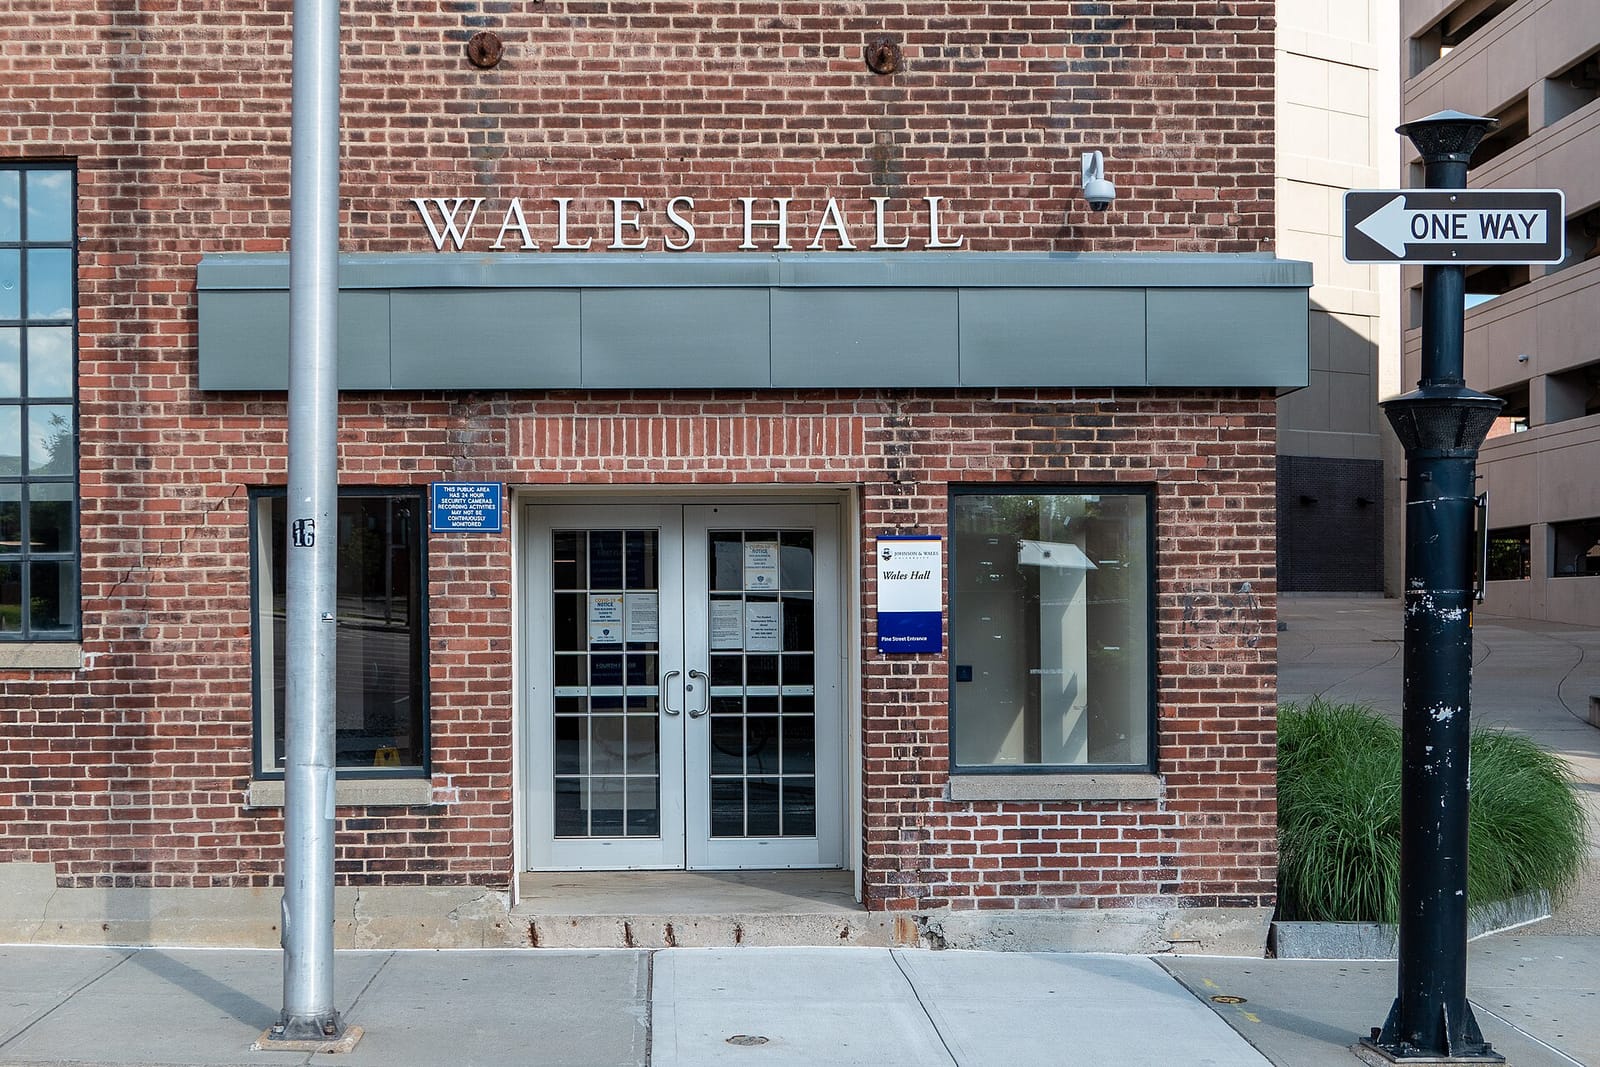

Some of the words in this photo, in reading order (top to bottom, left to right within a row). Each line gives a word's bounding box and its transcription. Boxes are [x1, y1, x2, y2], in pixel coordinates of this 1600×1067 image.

[410, 196, 695, 250] WALES
[738, 196, 964, 249] HALL
[1411, 213, 1468, 240] ONE
[1479, 213, 1539, 240] WAY
[295, 528, 314, 546] 16
[883, 570, 908, 580] Wales
[910, 570, 931, 580] Hall
